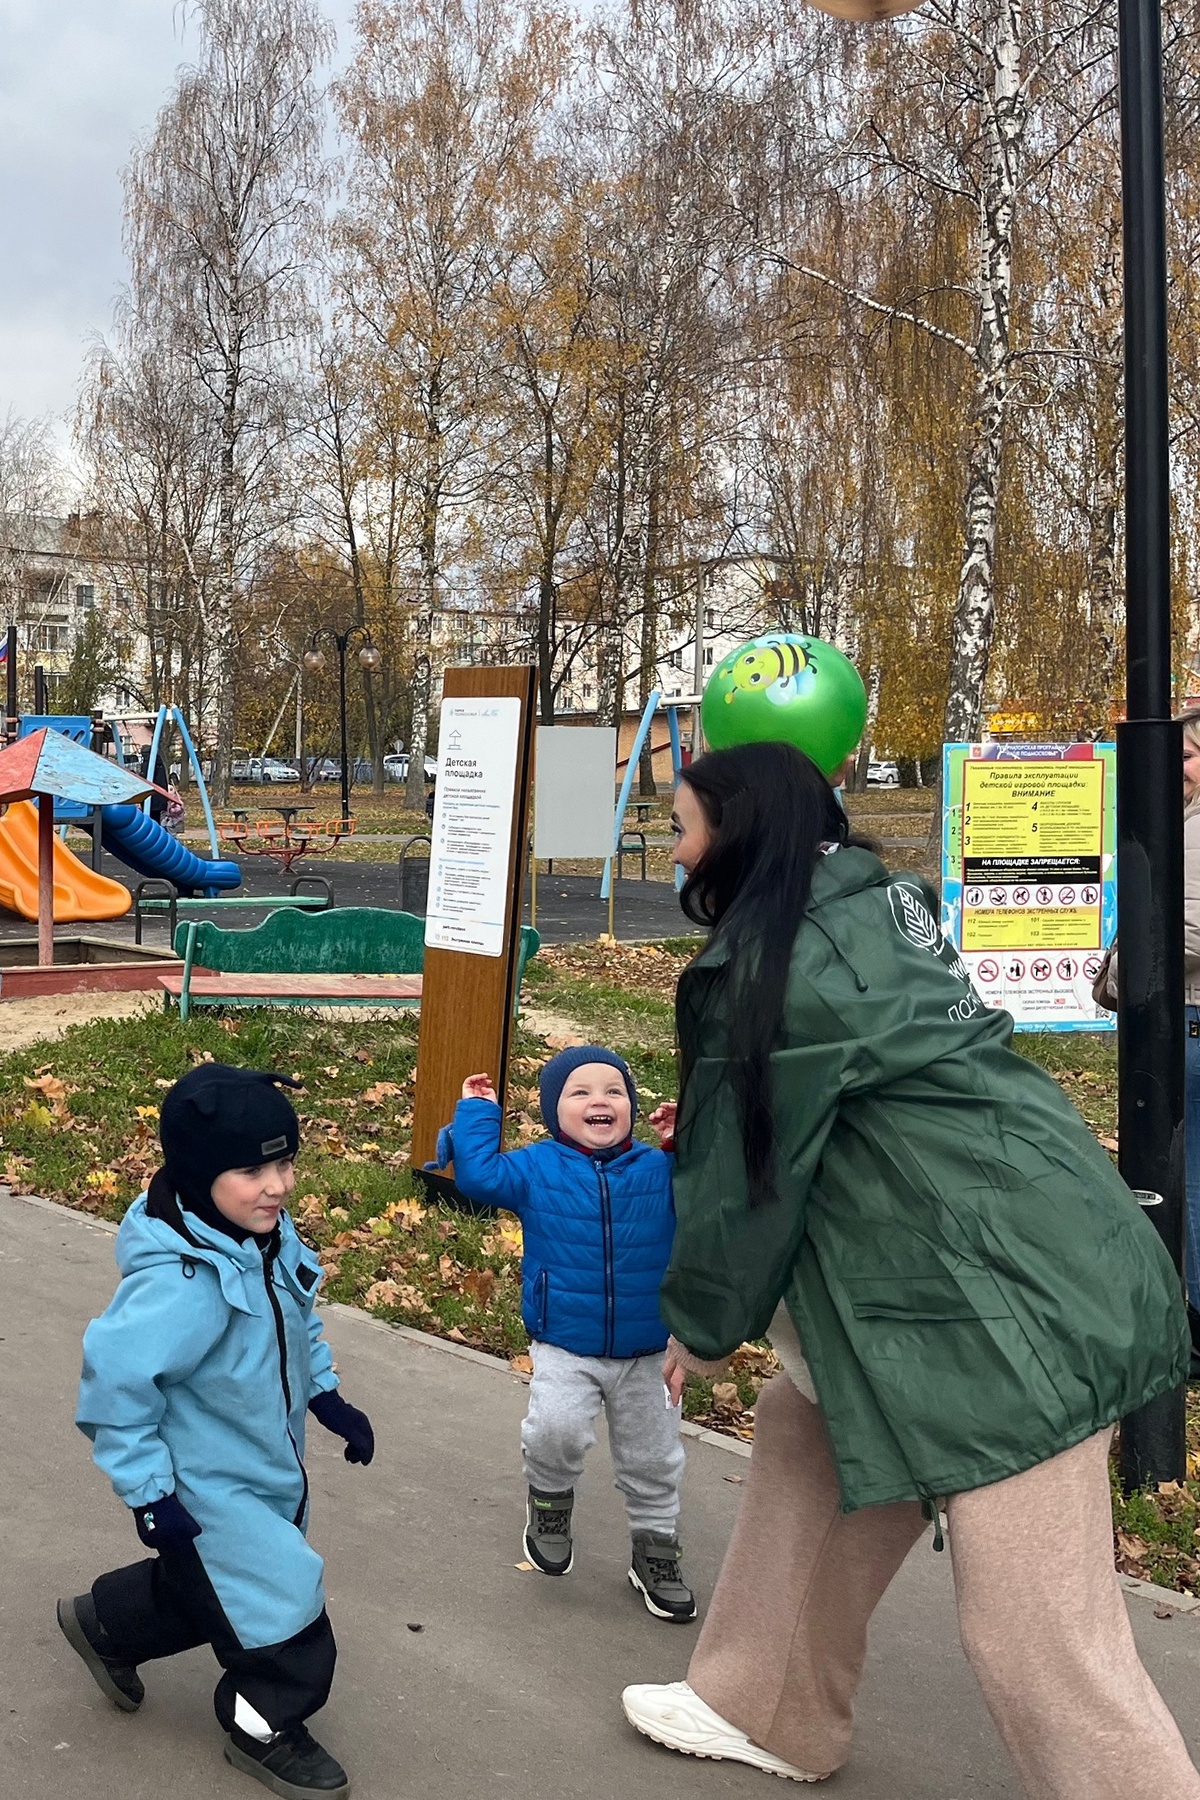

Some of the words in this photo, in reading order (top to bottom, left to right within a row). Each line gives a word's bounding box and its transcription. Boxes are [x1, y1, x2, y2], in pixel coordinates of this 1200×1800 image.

[445, 757, 477, 767] Детская
[444, 770, 483, 779] площадка
[989, 772, 1022, 780] Правила
[1024, 772, 1079, 780] эксплуатации
[1014, 781, 1046, 789] игровой
[1011, 790, 1056, 798] ВНИМАНИЕ
[965, 802, 971, 811] 1
[1031, 801, 1038, 811] 4
[965, 815, 971, 825] 2
[951, 826, 956, 835] 2
[1031, 823, 1038, 832] 5
[964, 836, 971, 845] 3
